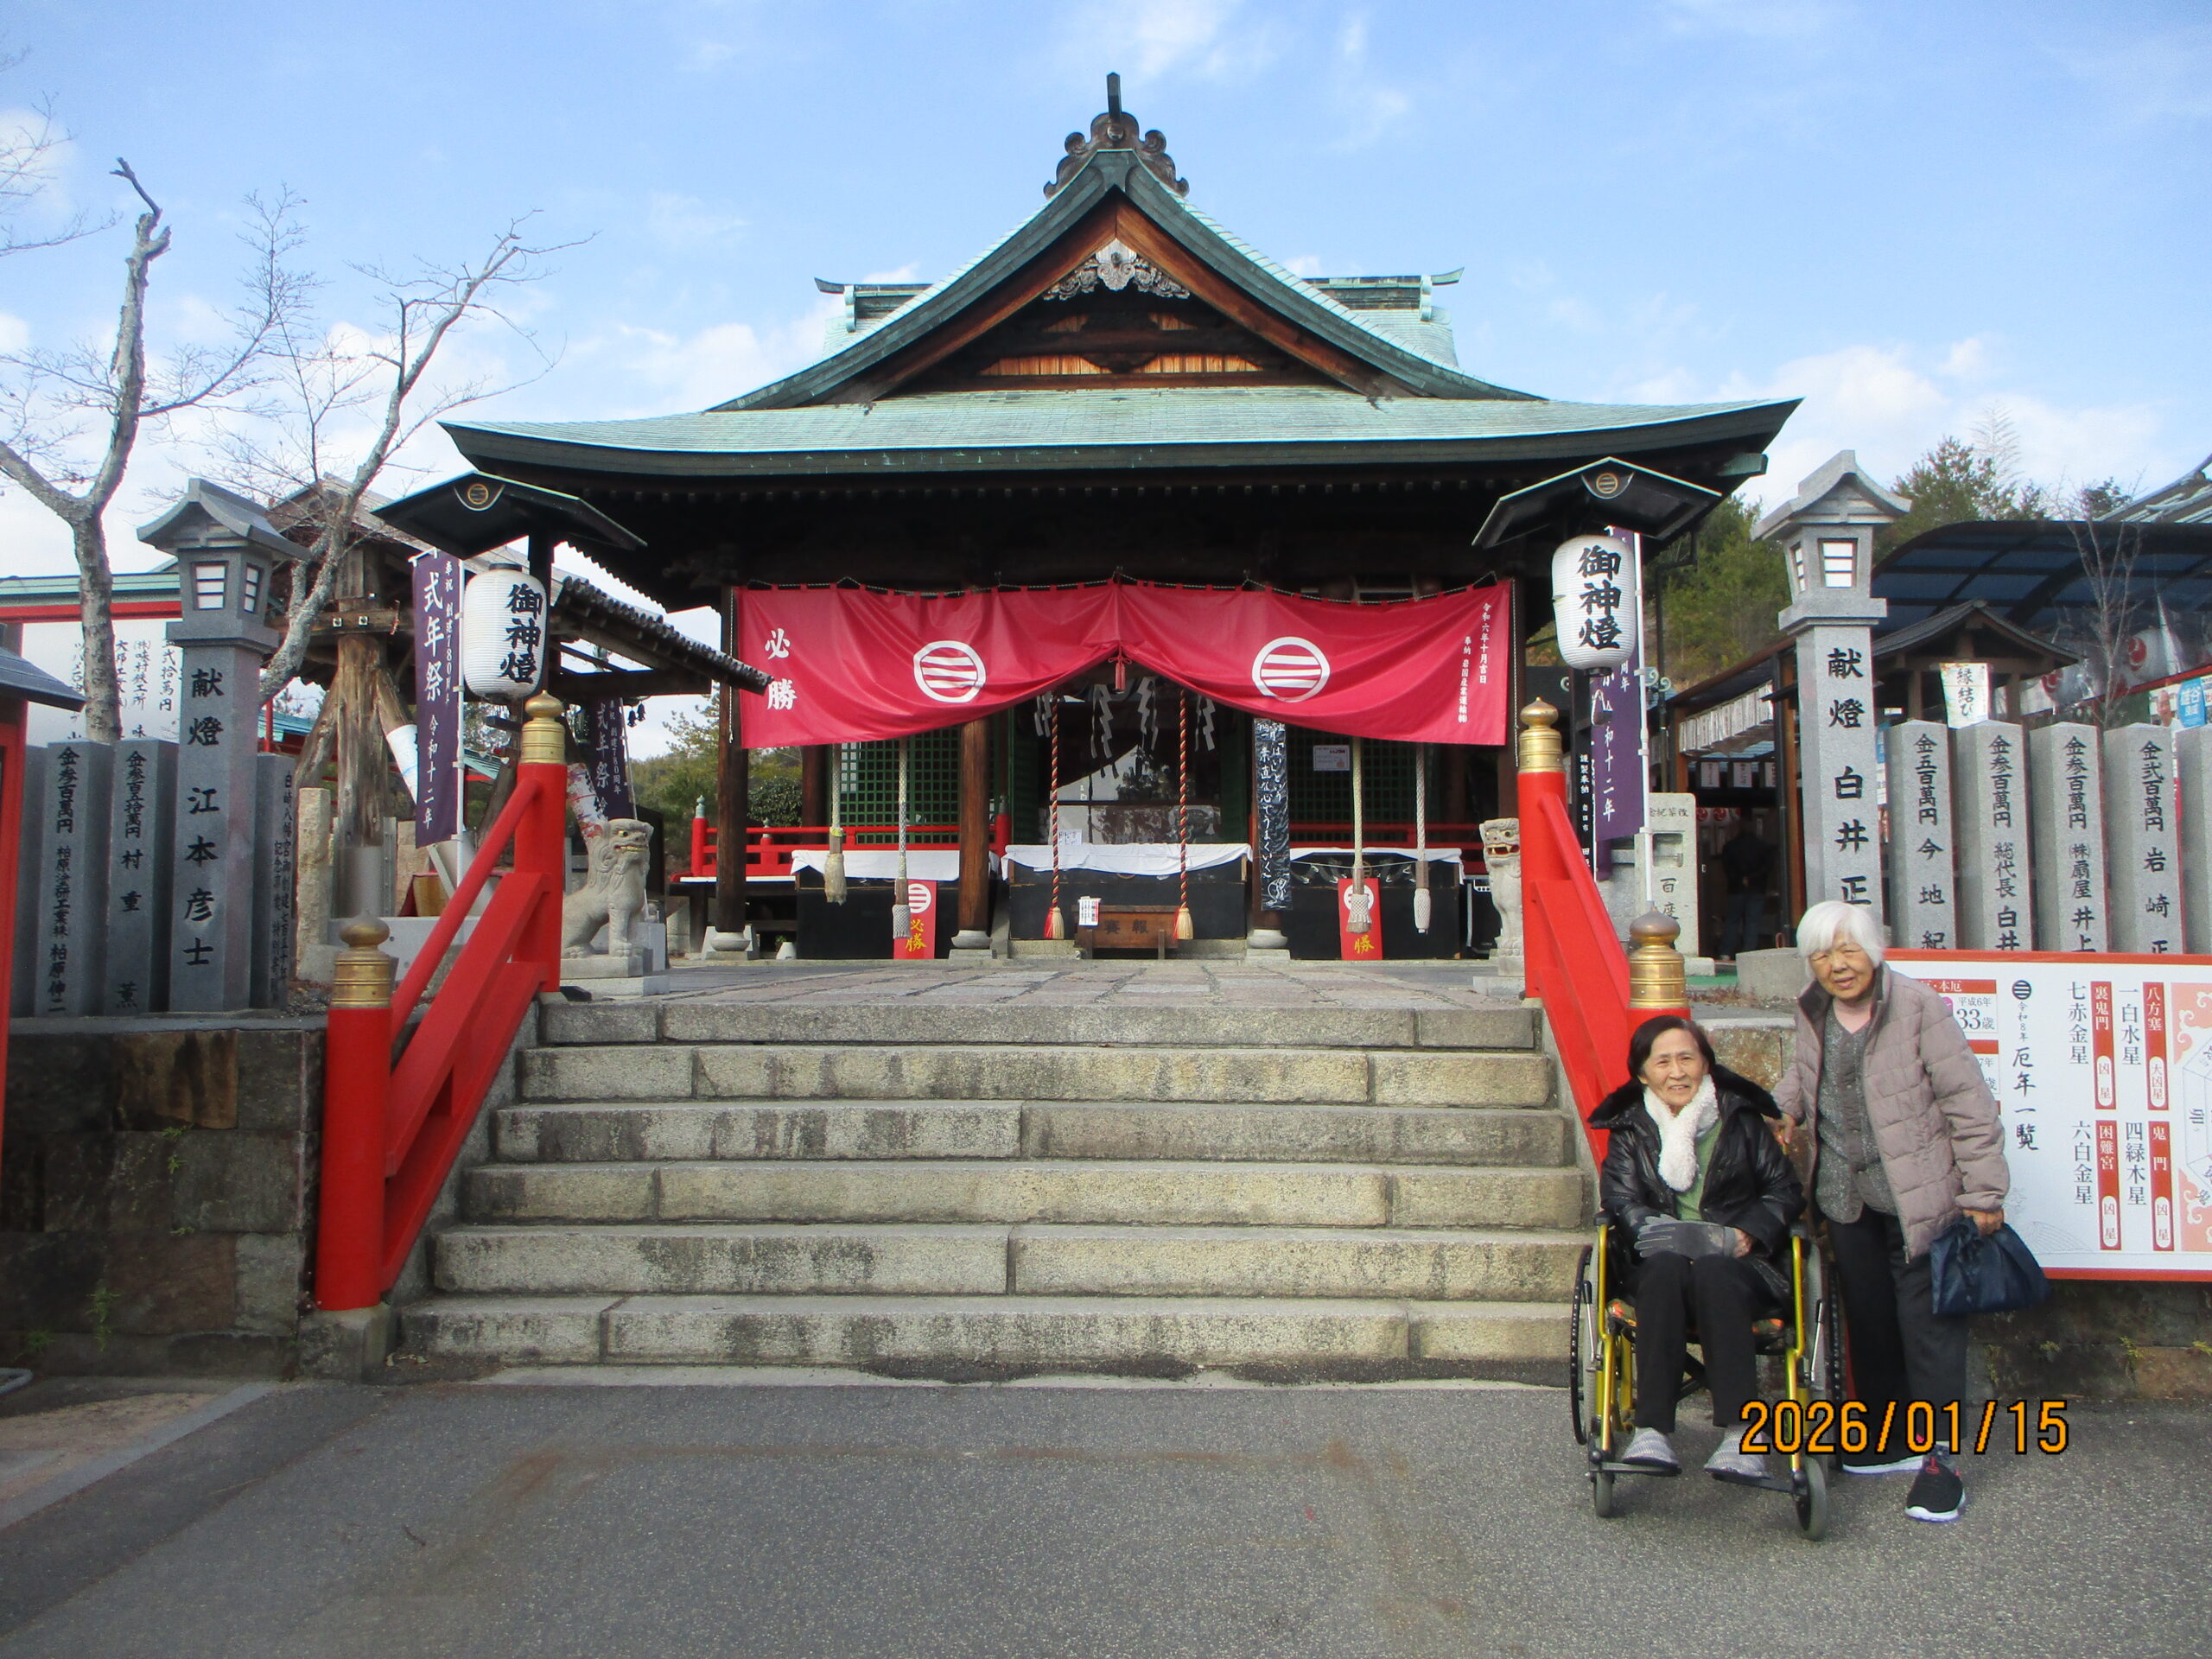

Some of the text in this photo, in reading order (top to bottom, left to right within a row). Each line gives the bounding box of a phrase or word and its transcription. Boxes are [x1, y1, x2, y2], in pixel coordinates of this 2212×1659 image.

[1577, 545, 1623, 650] 御神燈
[498, 583, 543, 684] 御神燈
[1479, 603, 1491, 684] 令和六年十月吉日
[423, 571, 445, 830] 式年祭 令和十二年
[765, 628, 798, 710] 必勝
[1957, 668, 1974, 716] 縁結び
[1827, 648, 1872, 906] 献燈 白井正
[1914, 733, 1937, 826] 金五百萬円
[182, 668, 225, 966] 献燈 江本彦士
[1993, 842, 2018, 899] 総代長
[1354, 935, 1375, 954] 勝
[1956, 1008, 1995, 1030] 33歳
[1958, 997, 1992, 1007] 平成6年
[2067, 981, 2089, 1065] 七赤金星
[2094, 986, 2109, 1031] 裏鬼門
[2119, 988, 2141, 1065] 一白水星
[2147, 987, 2162, 1031] 八方塞
[2012, 1046, 2039, 1151] 厄年一覧
[2099, 1063, 2111, 1099] 凶星
[2152, 1064, 2164, 1100] 大凶星
[2072, 1121, 2094, 1205] 六白金星
[2100, 1125, 2113, 1170] 困難宮
[2126, 1122, 2146, 1205] 四緑木星
[2152, 1126, 2167, 1171] 鬼門
[2104, 1203, 2116, 1240] 凶星
[2157, 1204, 2169, 1241] 凶星
